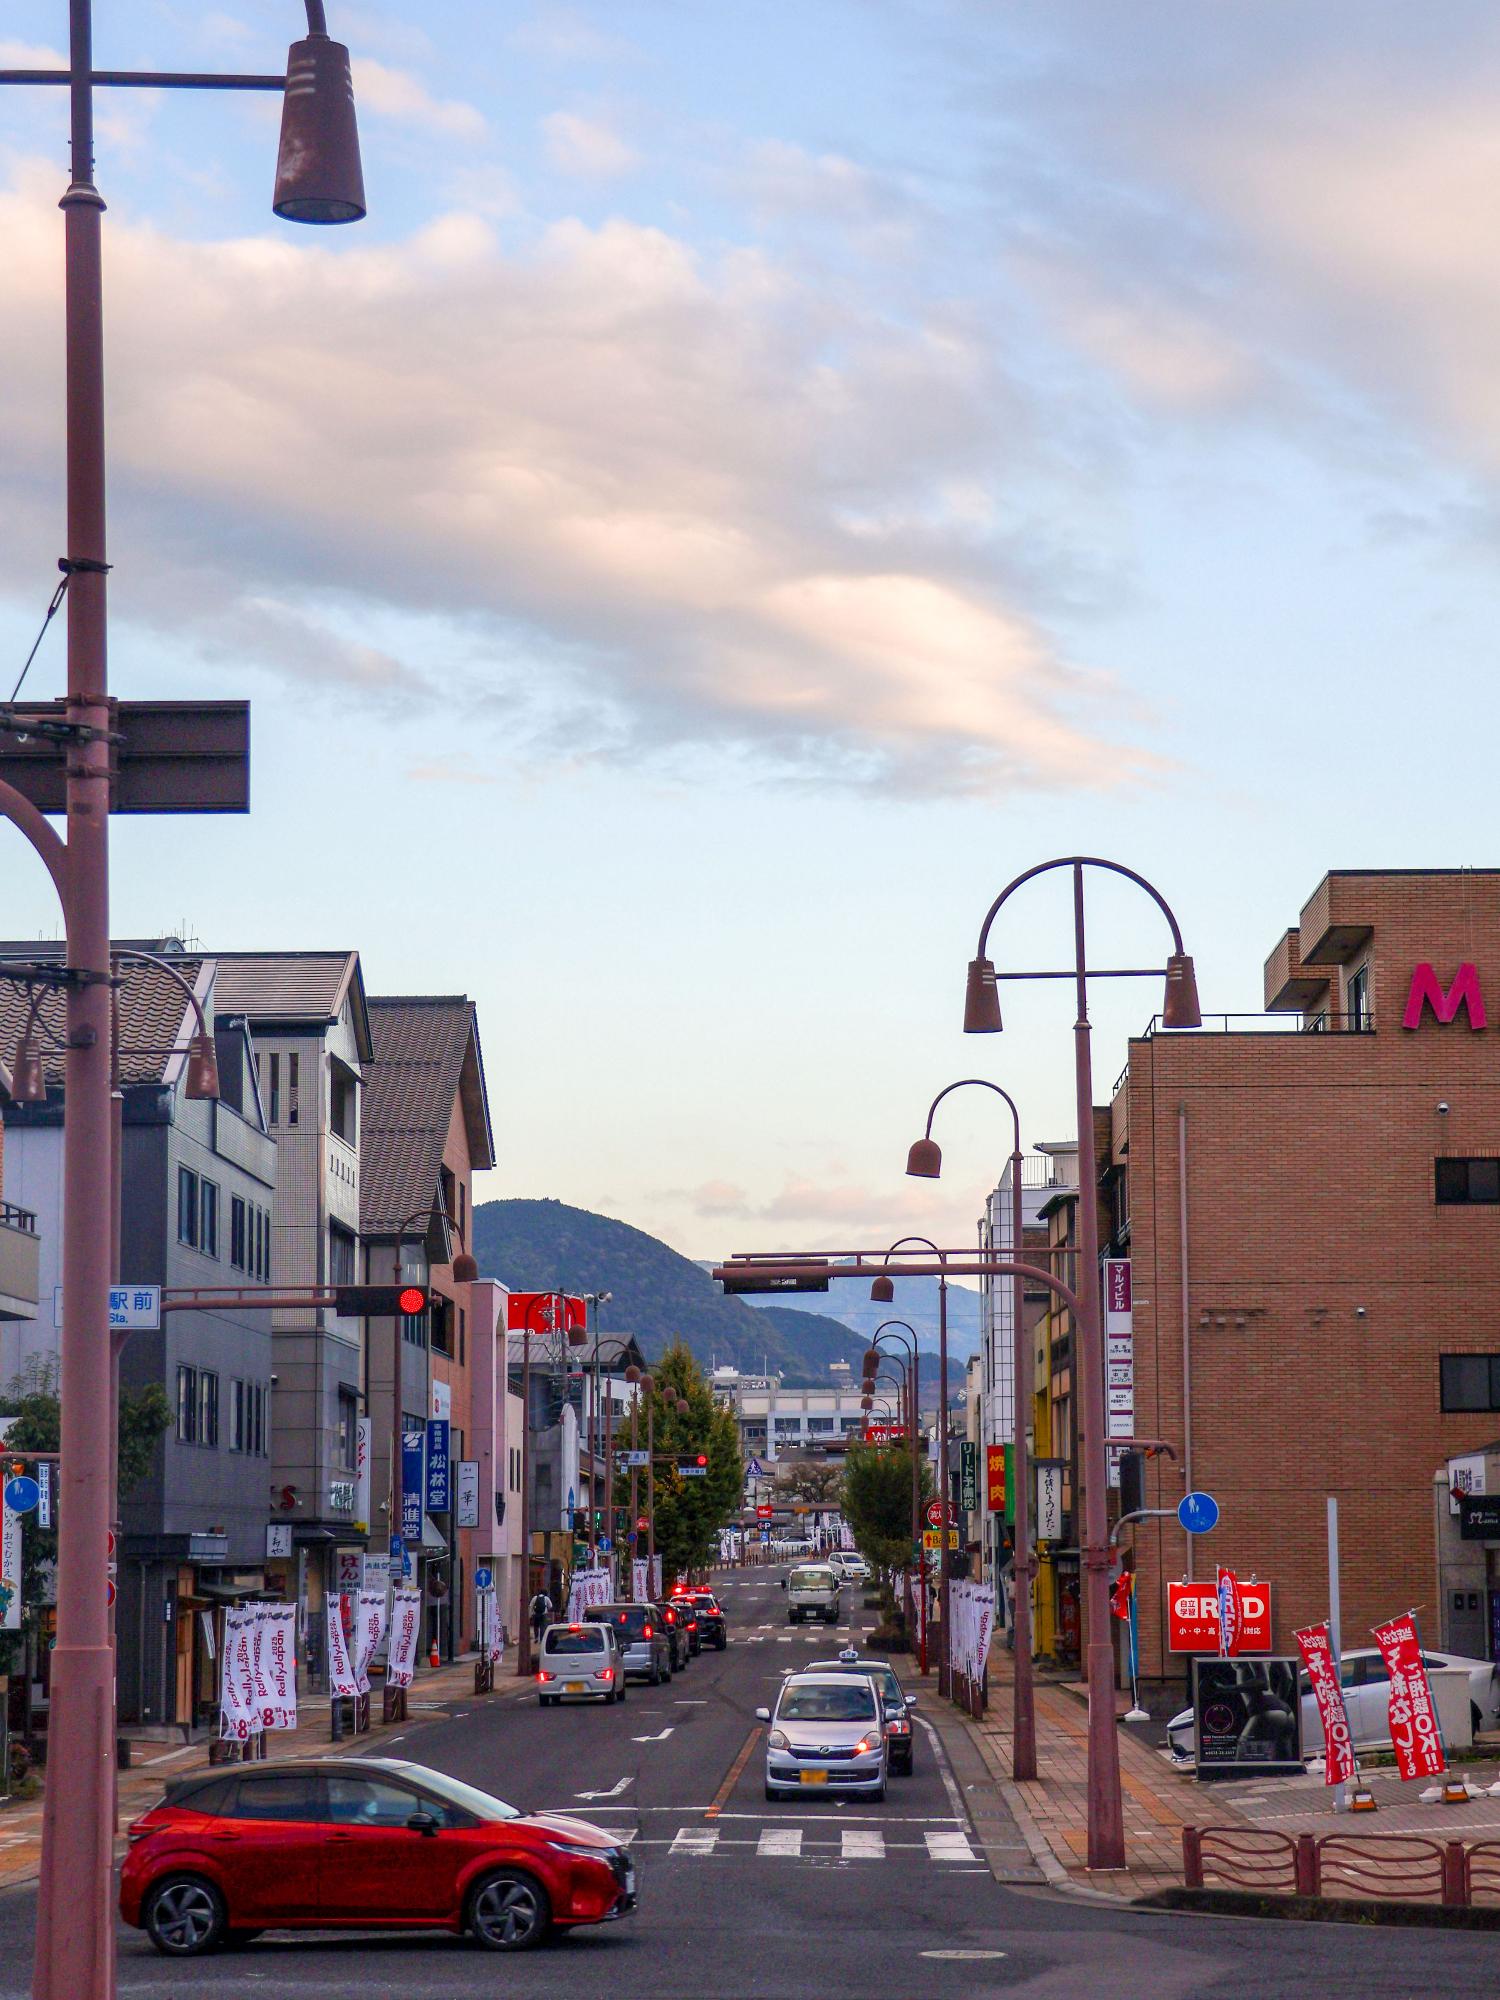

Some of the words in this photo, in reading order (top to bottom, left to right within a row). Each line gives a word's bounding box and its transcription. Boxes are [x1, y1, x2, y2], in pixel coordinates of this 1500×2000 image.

[1402, 961, 1488, 1030] M
[109, 1291, 153, 1311] 駅前
[1115, 1265, 1125, 1310] マルイビル
[429, 1454, 446, 1506] 松林堂
[963, 1443, 976, 1510] リード予備校
[989, 1455, 1005, 1501] 焼肉
[3, 1532, 14, 1578] おでむかえ
[340, 1555, 359, 1580] はん
[1200, 1597, 1265, 1619] RD
[400, 1609, 414, 1663] RallyJapan
[253, 1629, 269, 1697] RallyJapan
[274, 1629, 288, 1697] RallyJapan
